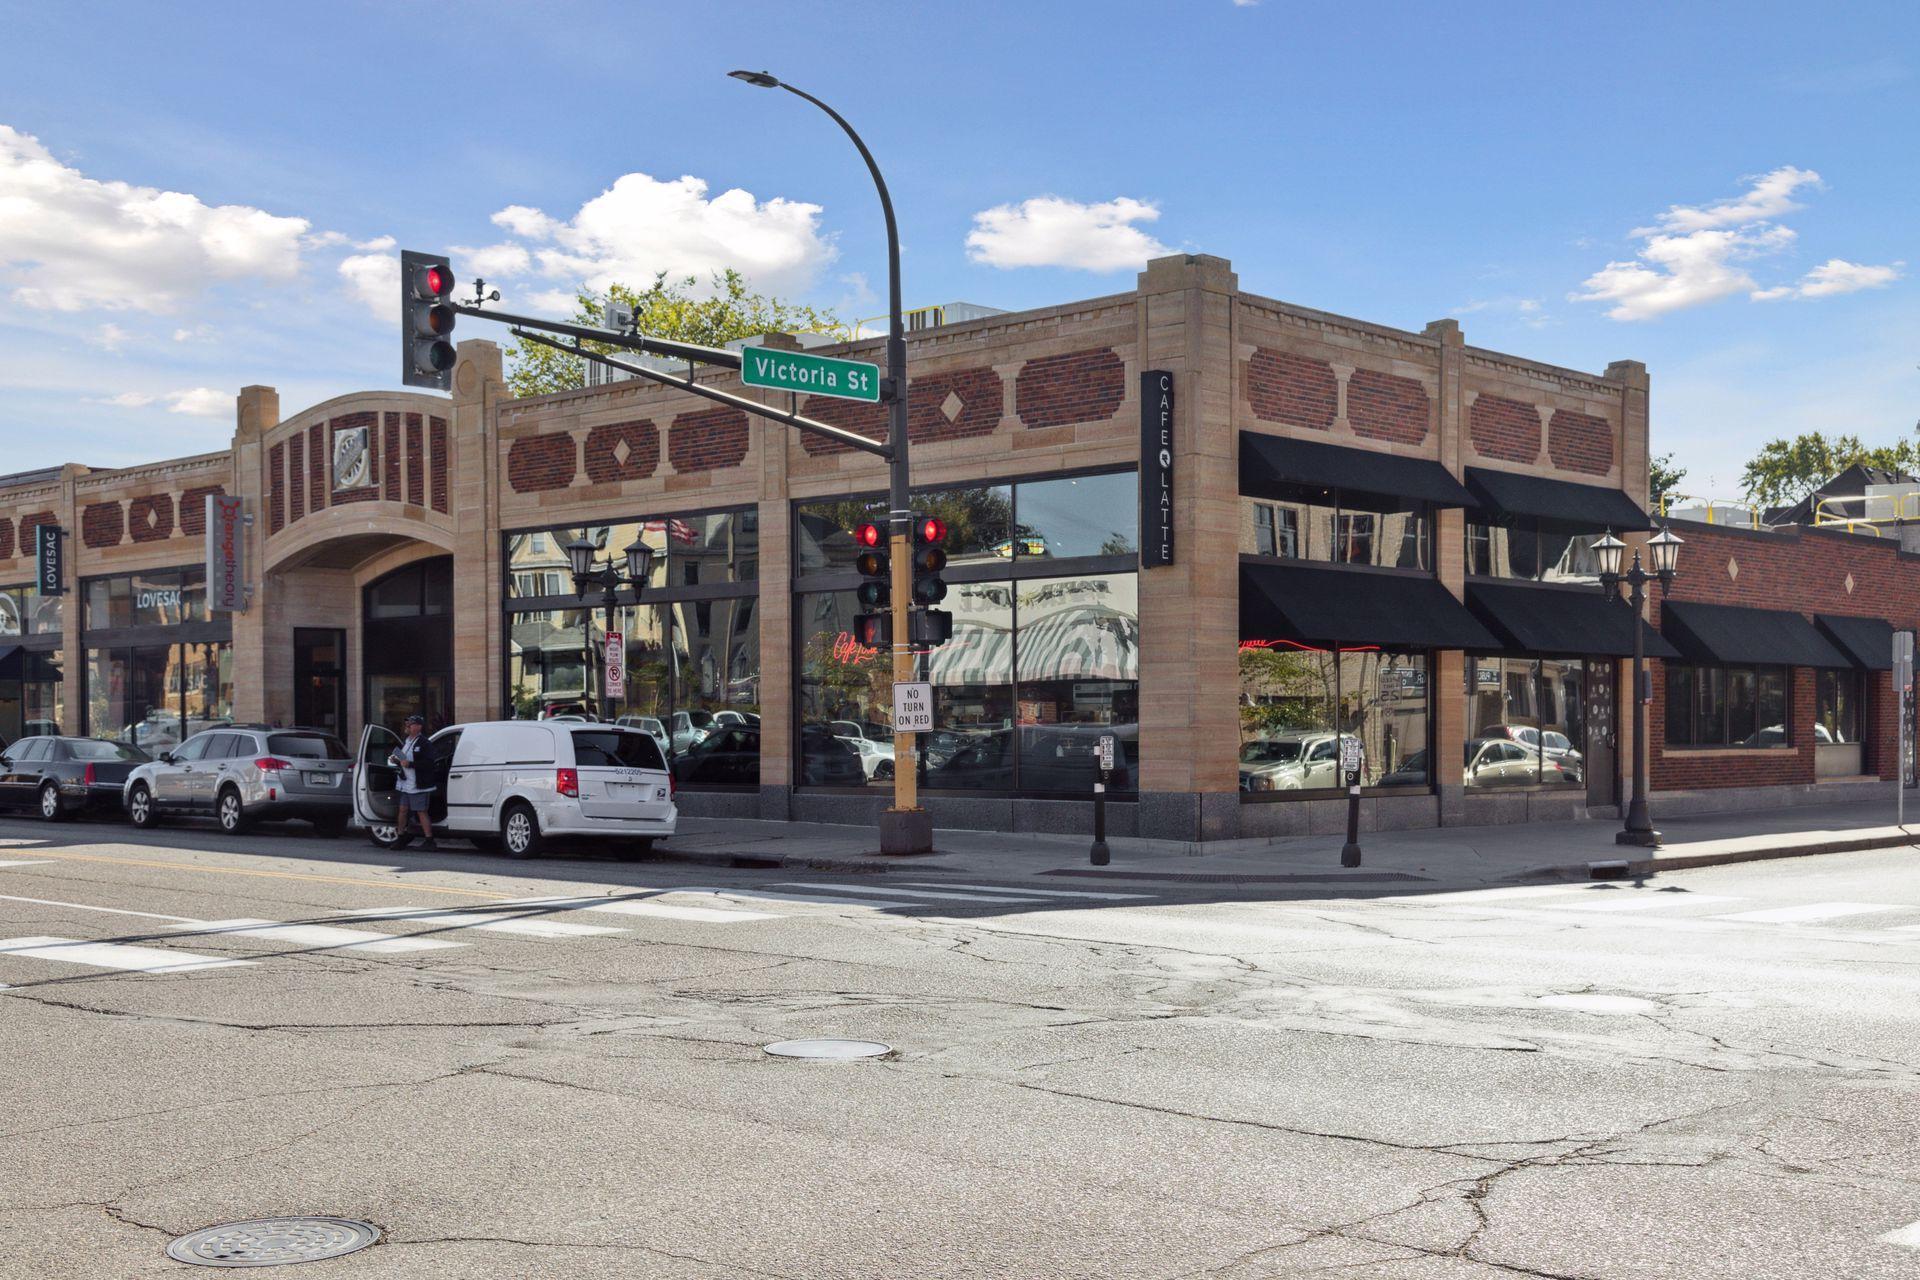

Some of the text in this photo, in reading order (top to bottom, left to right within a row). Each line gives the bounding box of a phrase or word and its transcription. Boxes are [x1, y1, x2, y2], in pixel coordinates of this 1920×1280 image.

[755, 357, 868, 391] Victoria St
[1160, 375, 1169, 560] CAFE LATTE
[46, 532, 56, 589] LOVESAC
[907, 689, 919, 699] NO
[903, 702, 924, 711] TURN
[898, 715, 929, 725] ON RED
